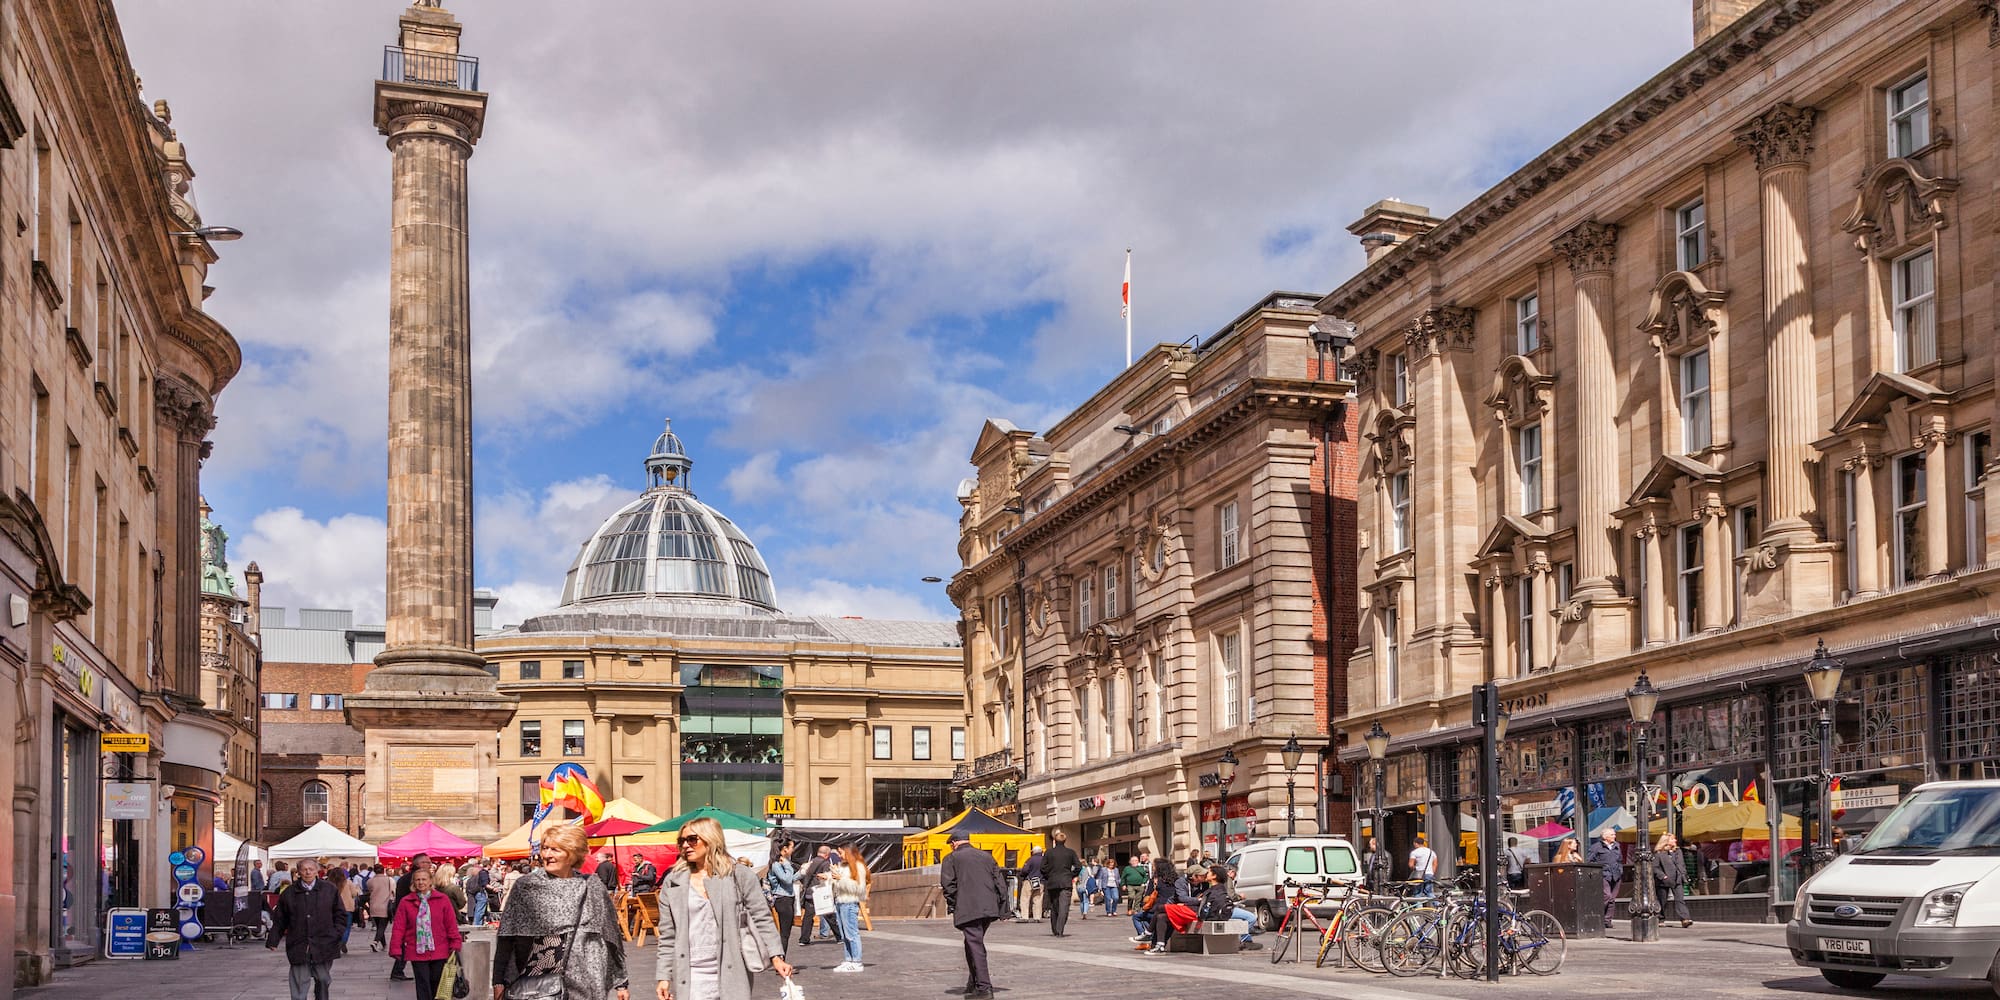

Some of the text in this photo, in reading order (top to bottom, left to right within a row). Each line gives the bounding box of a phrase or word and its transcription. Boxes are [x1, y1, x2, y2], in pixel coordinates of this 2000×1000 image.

[1626, 778, 1738, 815] BYRON
[1845, 788, 1874, 799] PROPER
[774, 799, 791, 811] M
[1824, 939, 1864, 952] YR61 GUC
